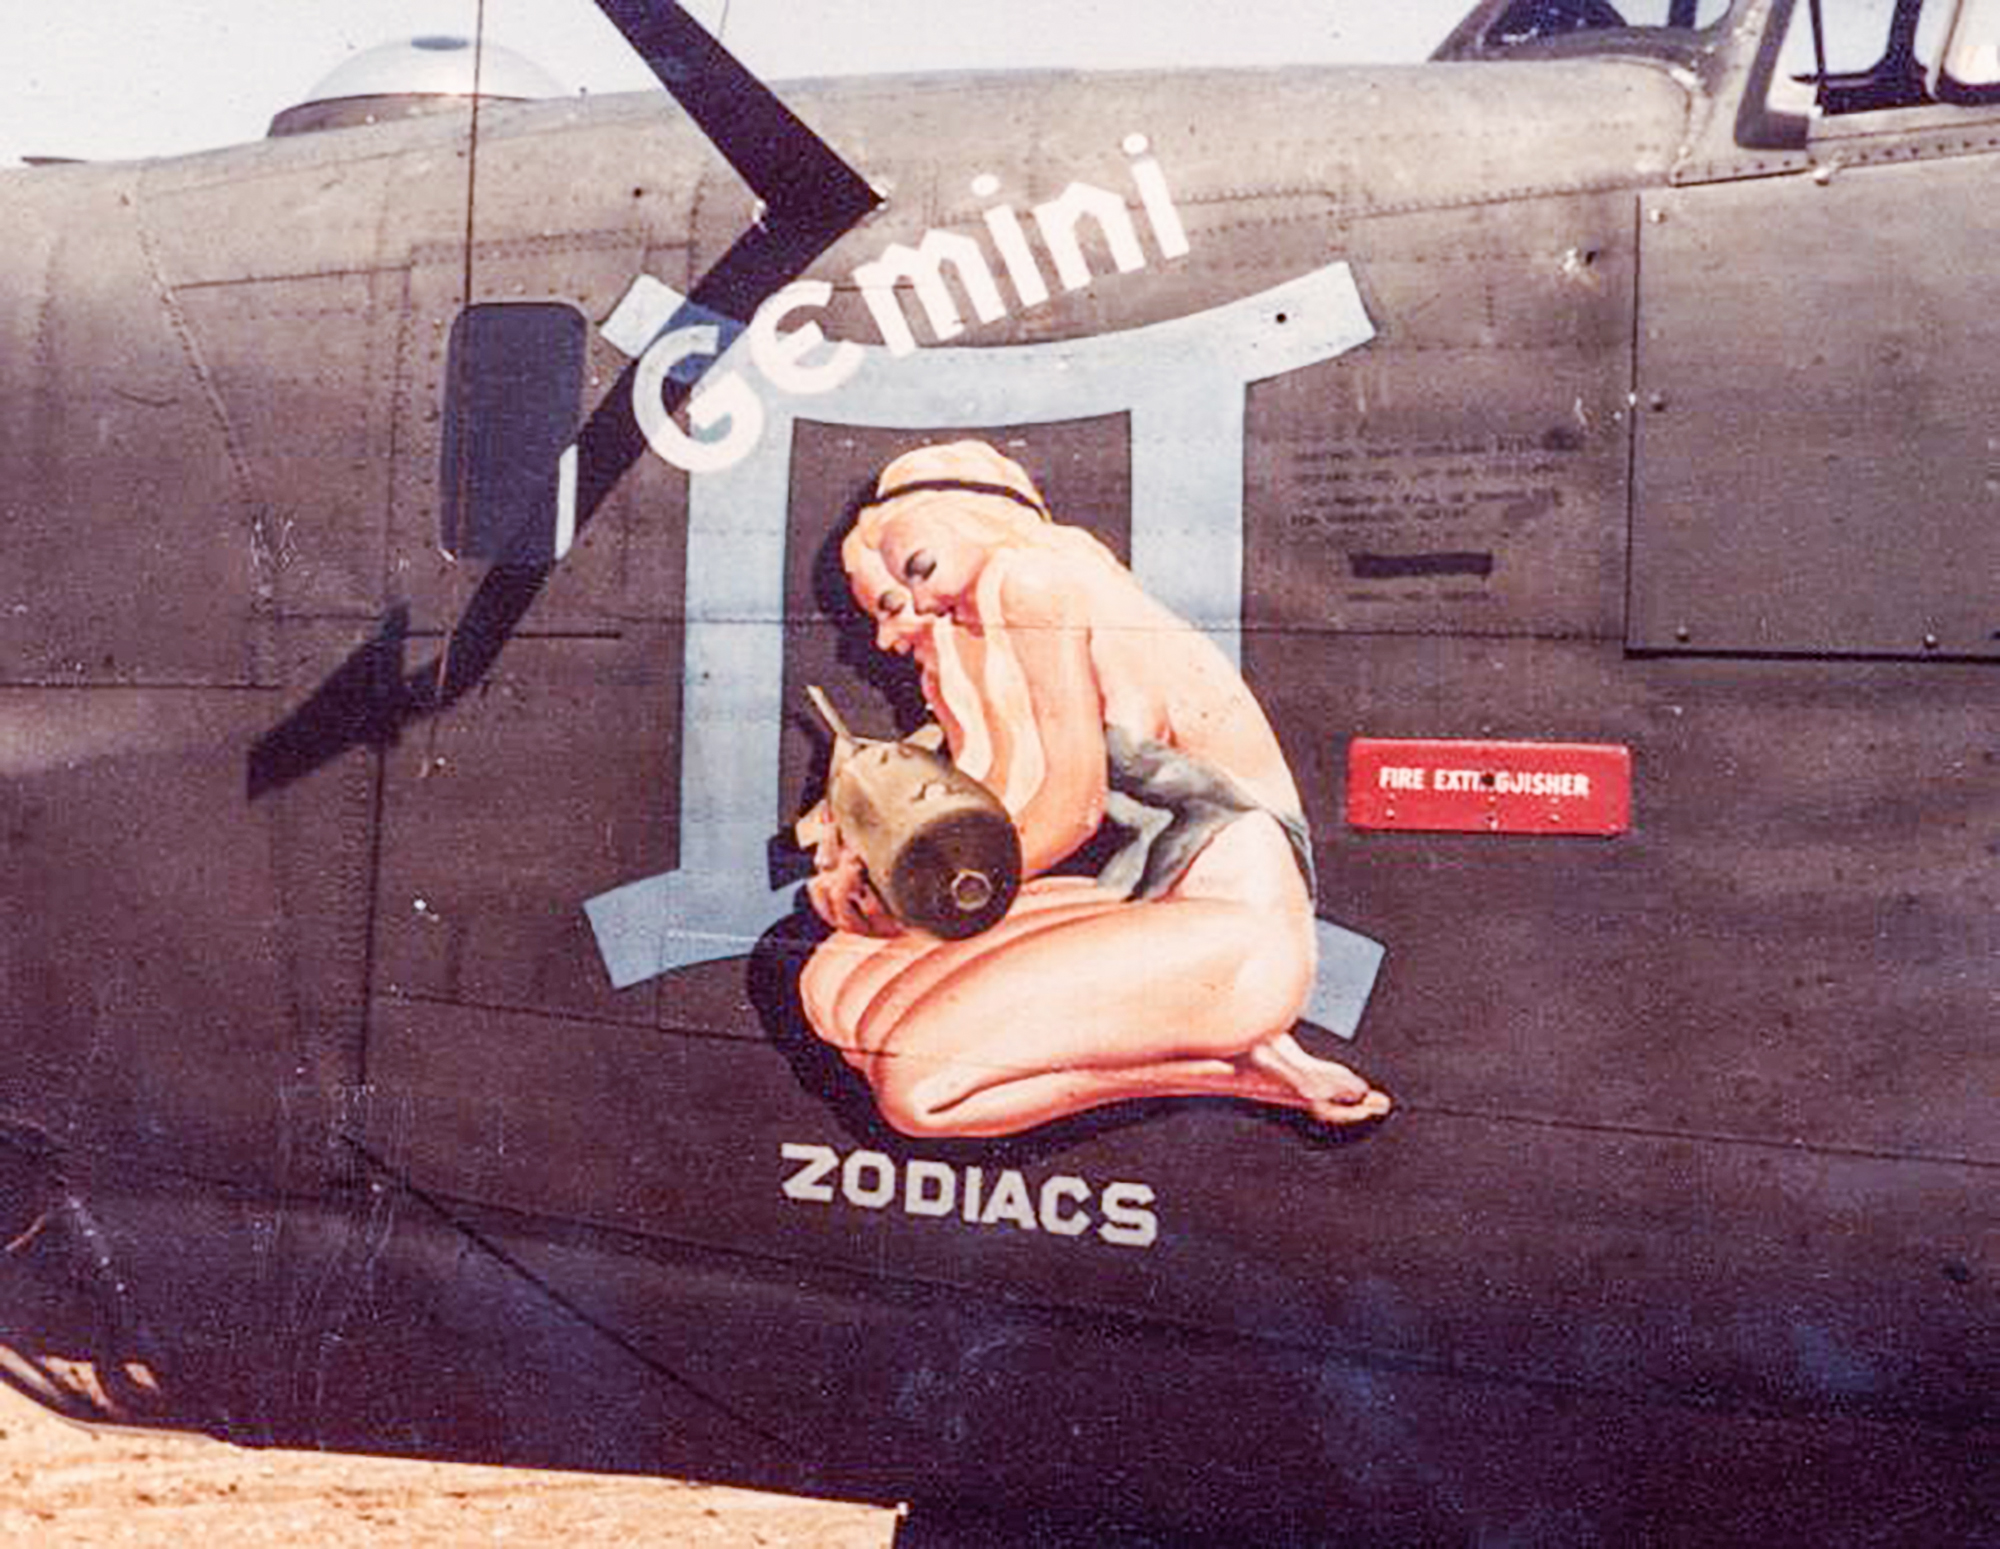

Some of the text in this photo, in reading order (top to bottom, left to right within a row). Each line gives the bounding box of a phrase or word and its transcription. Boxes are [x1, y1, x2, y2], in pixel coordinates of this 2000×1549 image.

[632, 133, 1189, 472] Gemini
[1378, 766, 1590, 797] FIRE EXTIGUISHER
[781, 1143, 1158, 1247] ZODIACS
